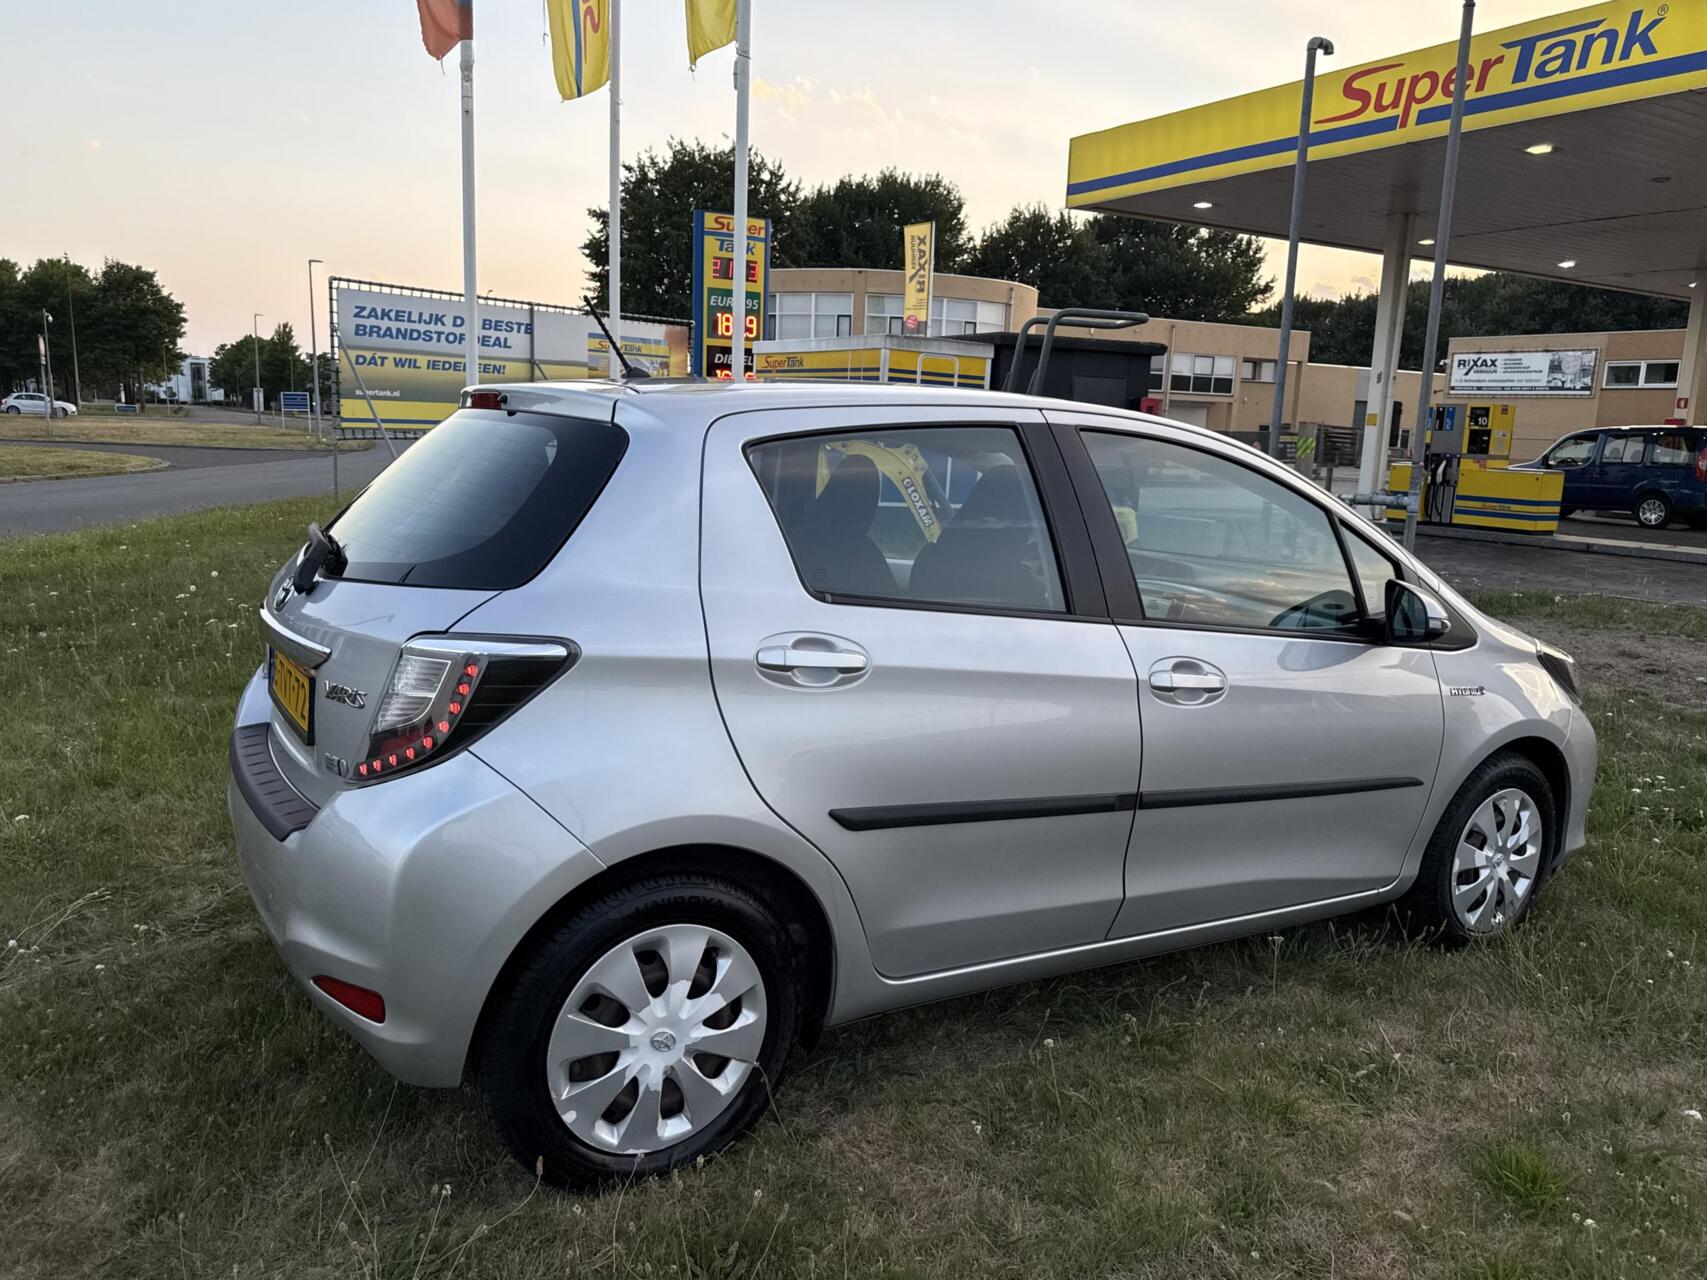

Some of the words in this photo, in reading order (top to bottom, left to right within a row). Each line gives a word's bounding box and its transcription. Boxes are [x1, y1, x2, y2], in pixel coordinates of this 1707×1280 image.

[704, 215, 765, 236] Suer
[715, 237, 756, 256] Tak
[746, 299, 760, 310] 95
[353, 305, 447, 327] ZAKELIJK
[481, 318, 534, 335] BESTE
[354, 352, 388, 368] DÁT
[393, 356, 421, 370] WIL
[426, 359, 507, 375] IEDEEN!
[714, 353, 754, 366] DIEEL
[355, 389, 401, 397] suertank.nl
[1478, 416, 1488, 426] 10
